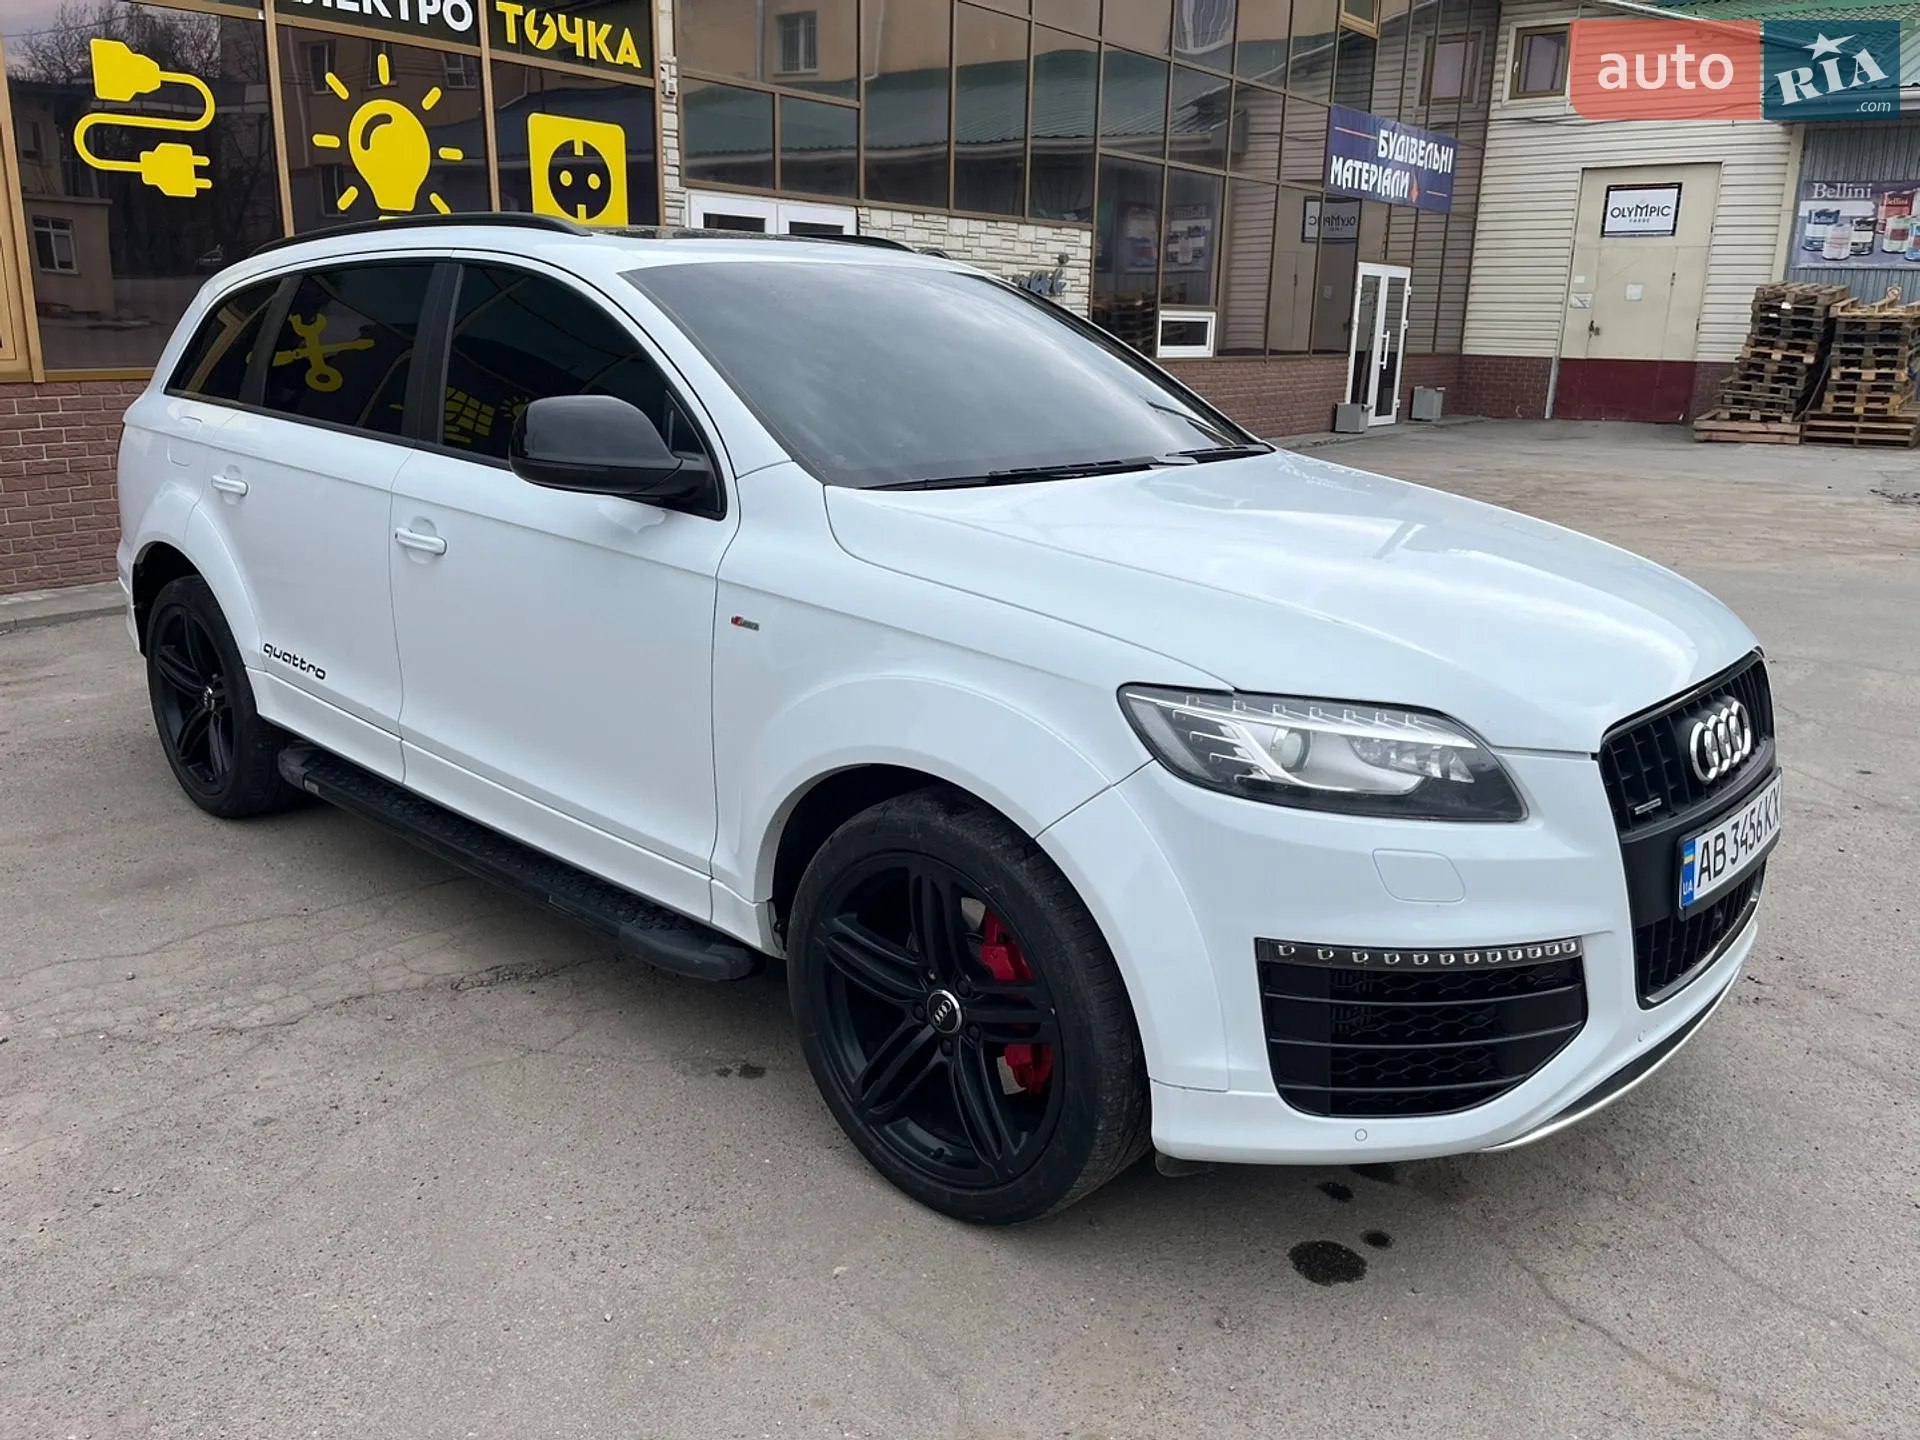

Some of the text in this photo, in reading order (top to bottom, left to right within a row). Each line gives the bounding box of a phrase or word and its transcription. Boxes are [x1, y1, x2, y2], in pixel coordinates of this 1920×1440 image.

[292, 0, 642, 69] КТРО ТОЧКА
[1377, 129, 1454, 174] БУДІВЕЛЬНІ
[1330, 154, 1410, 198] МАТЕРІАЛИ
[1812, 183, 1872, 199] Bellini
[1610, 204, 1672, 218] OLYMPIC
[263, 643, 326, 680] quattro
[1697, 831, 1726, 888] AB
[1730, 801, 1762, 865] 3456
[1682, 879, 1693, 896] UA
